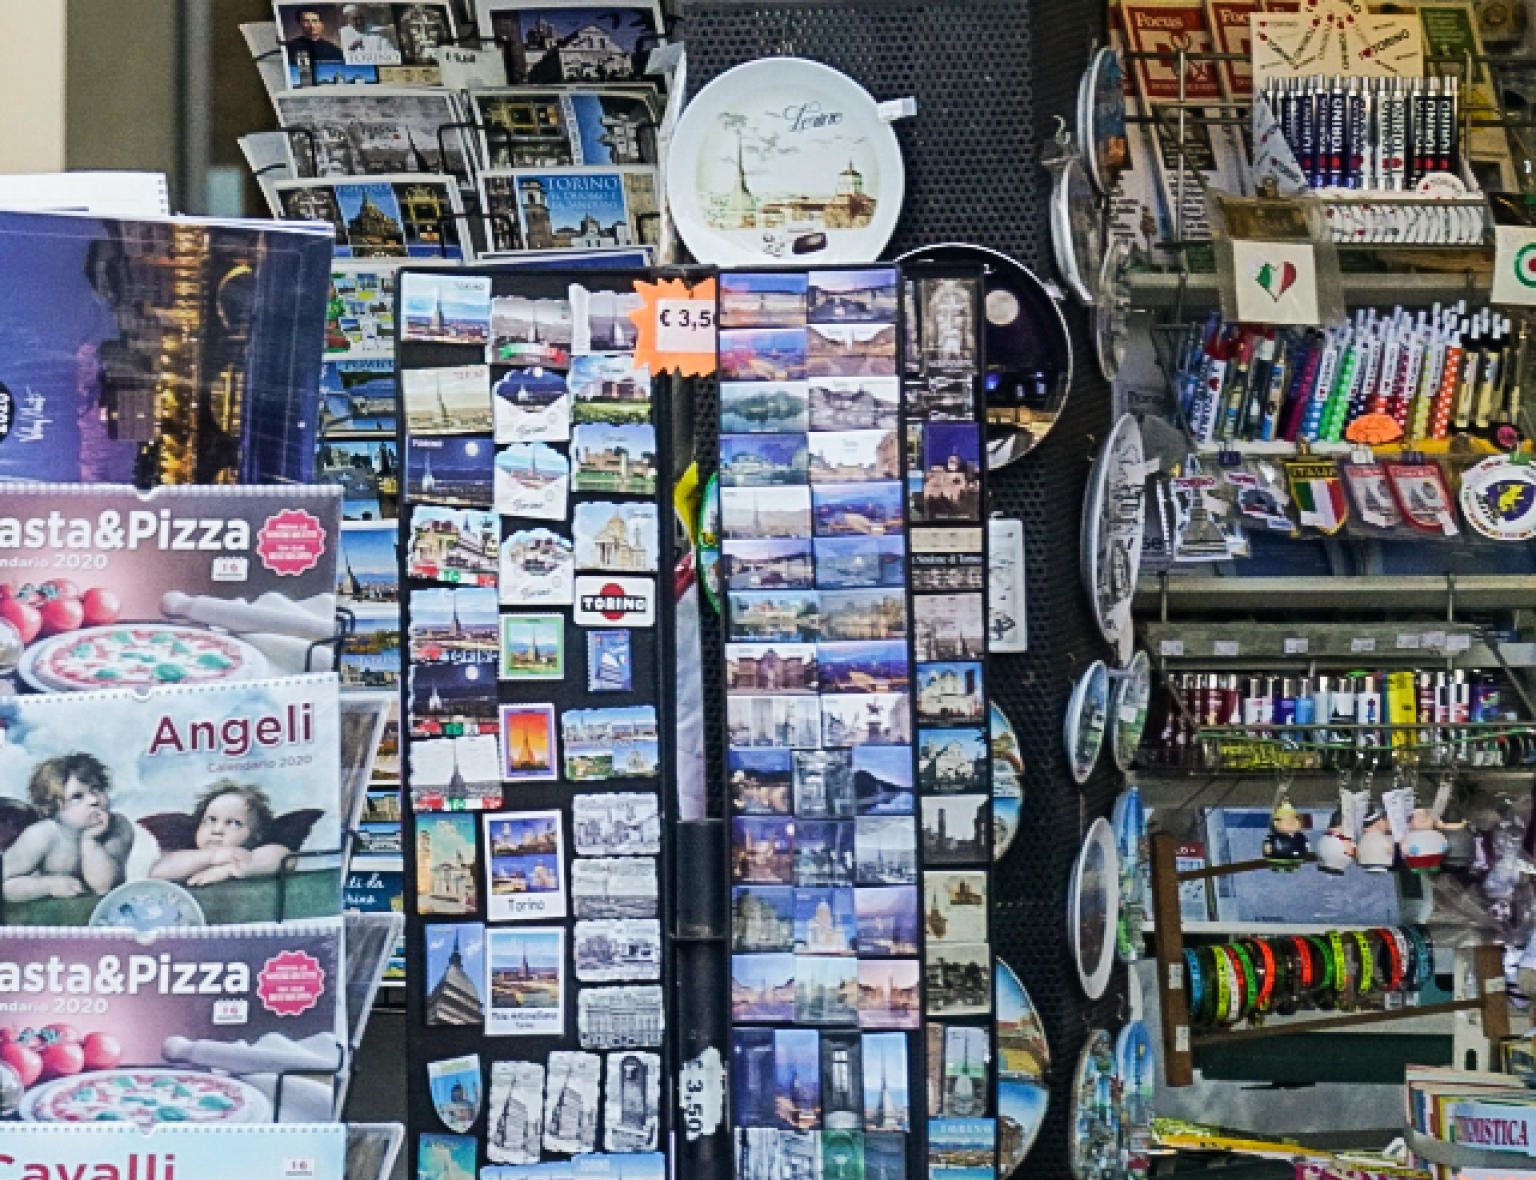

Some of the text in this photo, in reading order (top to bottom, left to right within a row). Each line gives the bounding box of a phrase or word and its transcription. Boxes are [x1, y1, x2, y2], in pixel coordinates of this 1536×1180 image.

[677, 310, 716, 331] 3,5
[54, 554, 108, 569] 2020
[583, 596, 647, 612] TORINO
[148, 702, 314, 756] Angeli
[207, 754, 313, 774] Calendario 2020
[54, 998, 108, 1014] 2020
